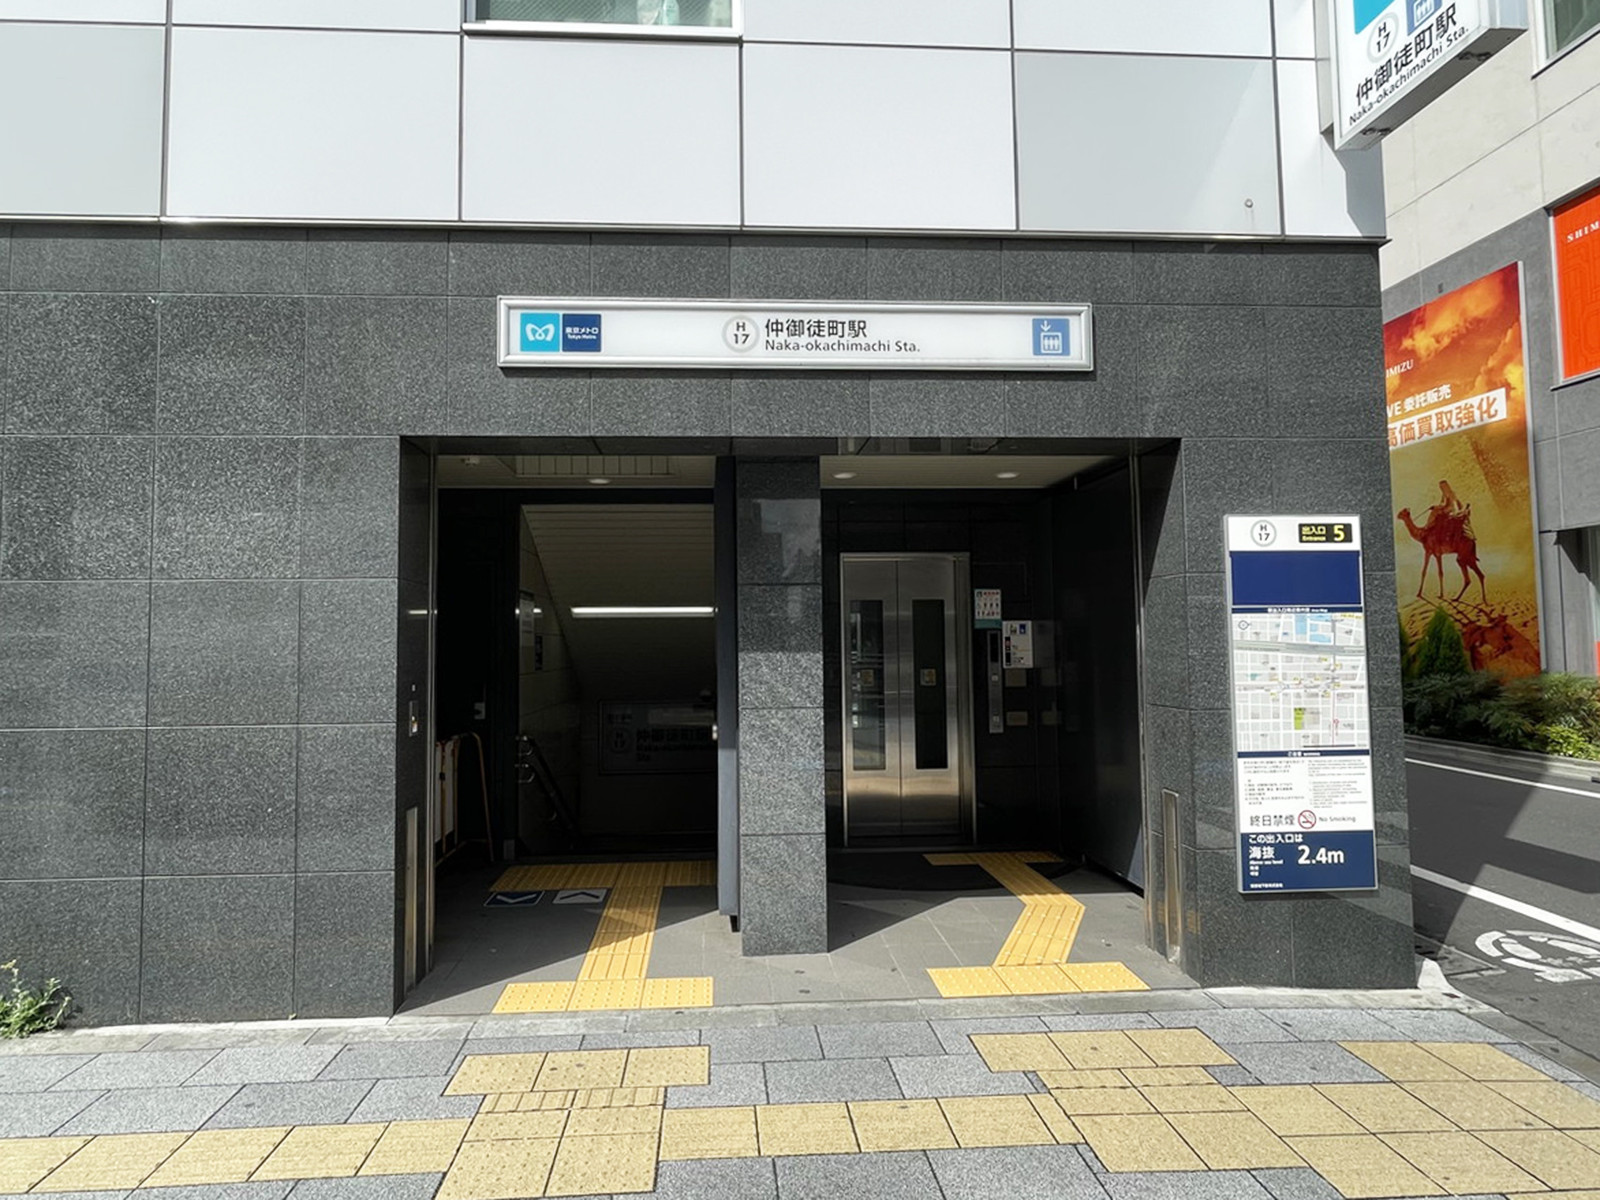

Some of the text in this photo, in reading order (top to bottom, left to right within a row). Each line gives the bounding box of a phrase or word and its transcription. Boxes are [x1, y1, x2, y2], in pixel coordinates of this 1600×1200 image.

[1378, 22, 1387, 38] H
[1376, 31, 1391, 53] 17
[1355, 2, 1457, 107] 仲御徒町駅
[1348, 26, 1469, 126] Naka-okachimachi Sta.
[736, 321, 747, 332] H
[764, 318, 867, 339] 仲御徒町駅
[732, 333, 750, 345] 17
[765, 339, 921, 352] Naka-okachimachi Sta.
[1258, 533, 1271, 541] 17
[1333, 524, 1345, 542] 5
[1250, 814, 1295, 827] 終日禁煙
[1248, 833, 1303, 844] この出入口は
[1297, 844, 1345, 865] 2.4m
